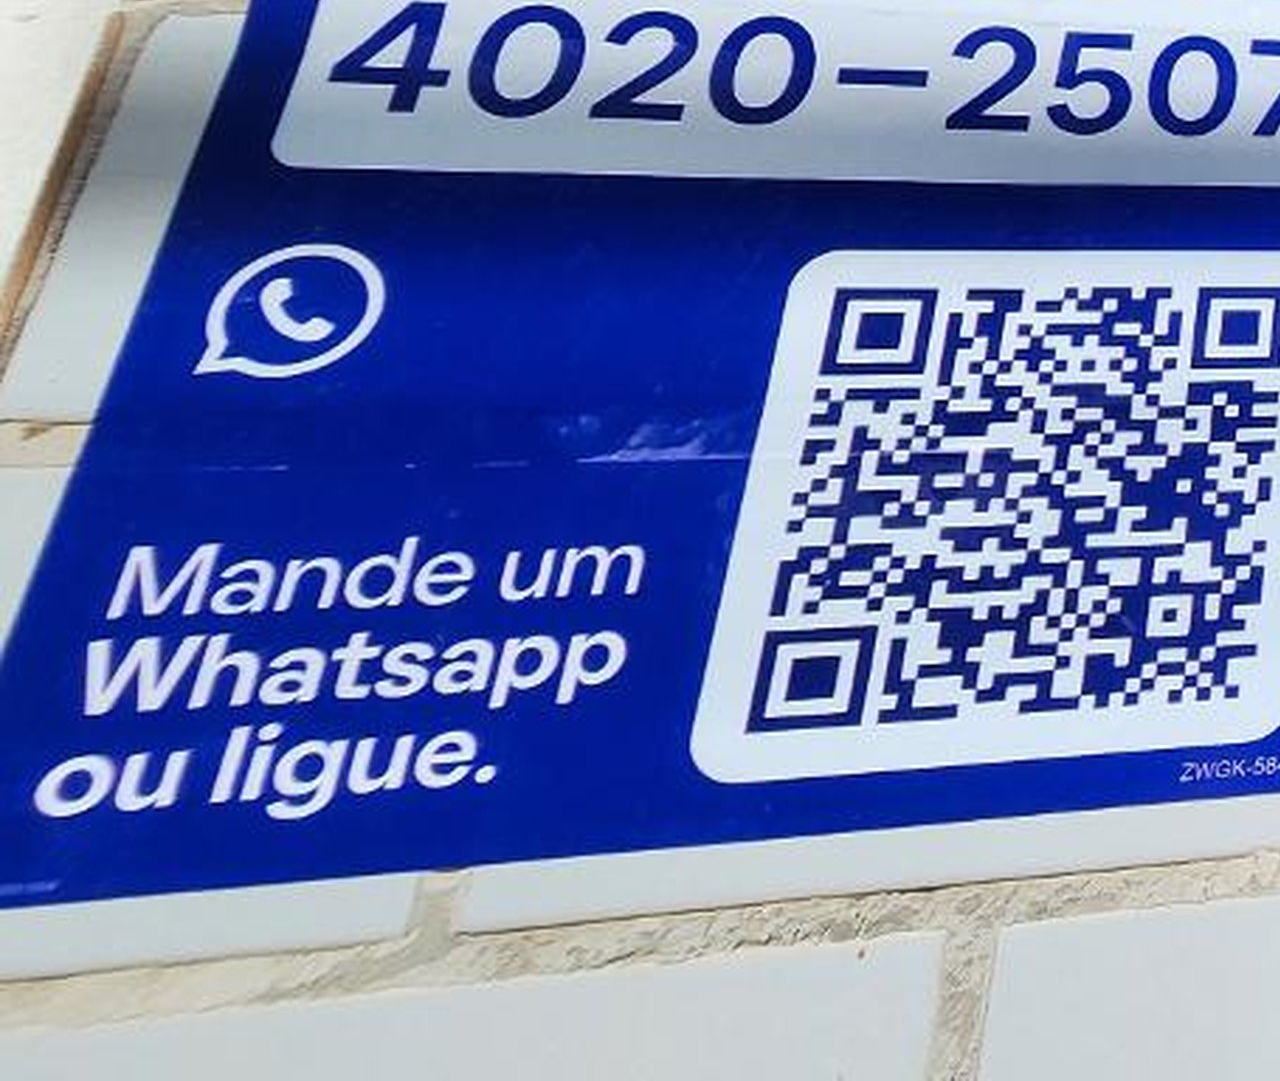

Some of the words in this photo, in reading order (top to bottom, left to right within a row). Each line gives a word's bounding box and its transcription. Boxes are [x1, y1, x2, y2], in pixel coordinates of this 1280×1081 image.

[106, 536, 475, 619] Mande
[500, 544, 646, 602] um
[84, 631, 628, 717] Whatsapp
[33, 749, 195, 818] ou
[208, 722, 498, 820] ligue.
